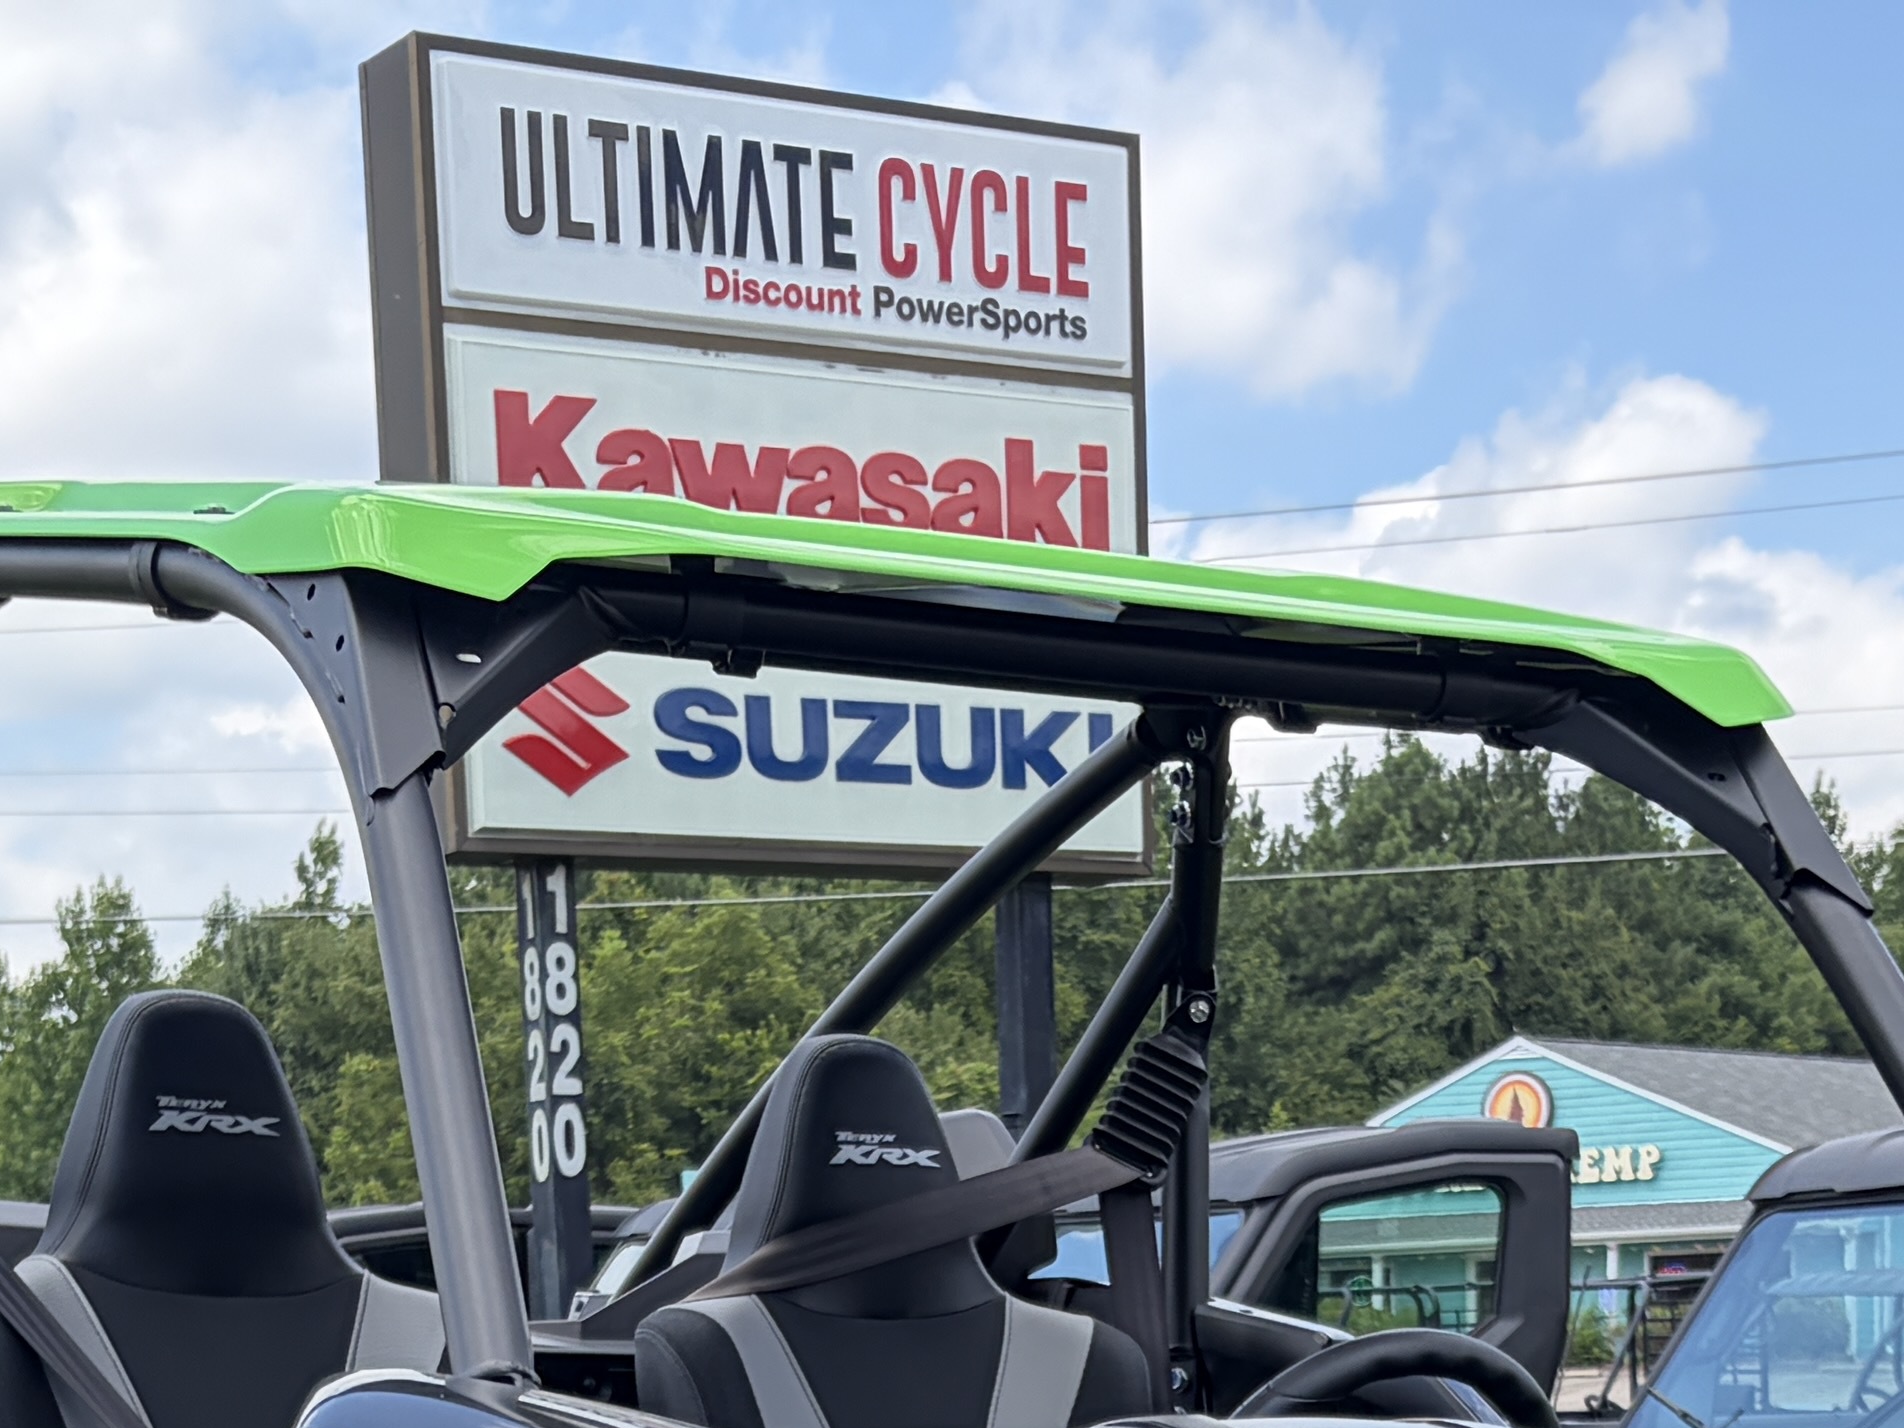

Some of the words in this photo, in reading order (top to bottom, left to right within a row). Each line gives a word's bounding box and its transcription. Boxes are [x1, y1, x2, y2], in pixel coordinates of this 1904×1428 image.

[499, 106, 857, 272] ULTIMATE
[877, 156, 1090, 299] CYCLE
[704, 265, 862, 316] Discount
[872, 285, 1088, 343] PowerSports
[494, 387, 1111, 551] Kawasaki
[545, 863, 587, 1178] 1820
[148, 1110, 281, 1137] KRX
[828, 1144, 941, 1168] KRX
[1570, 1143, 1661, 1184] EMP
